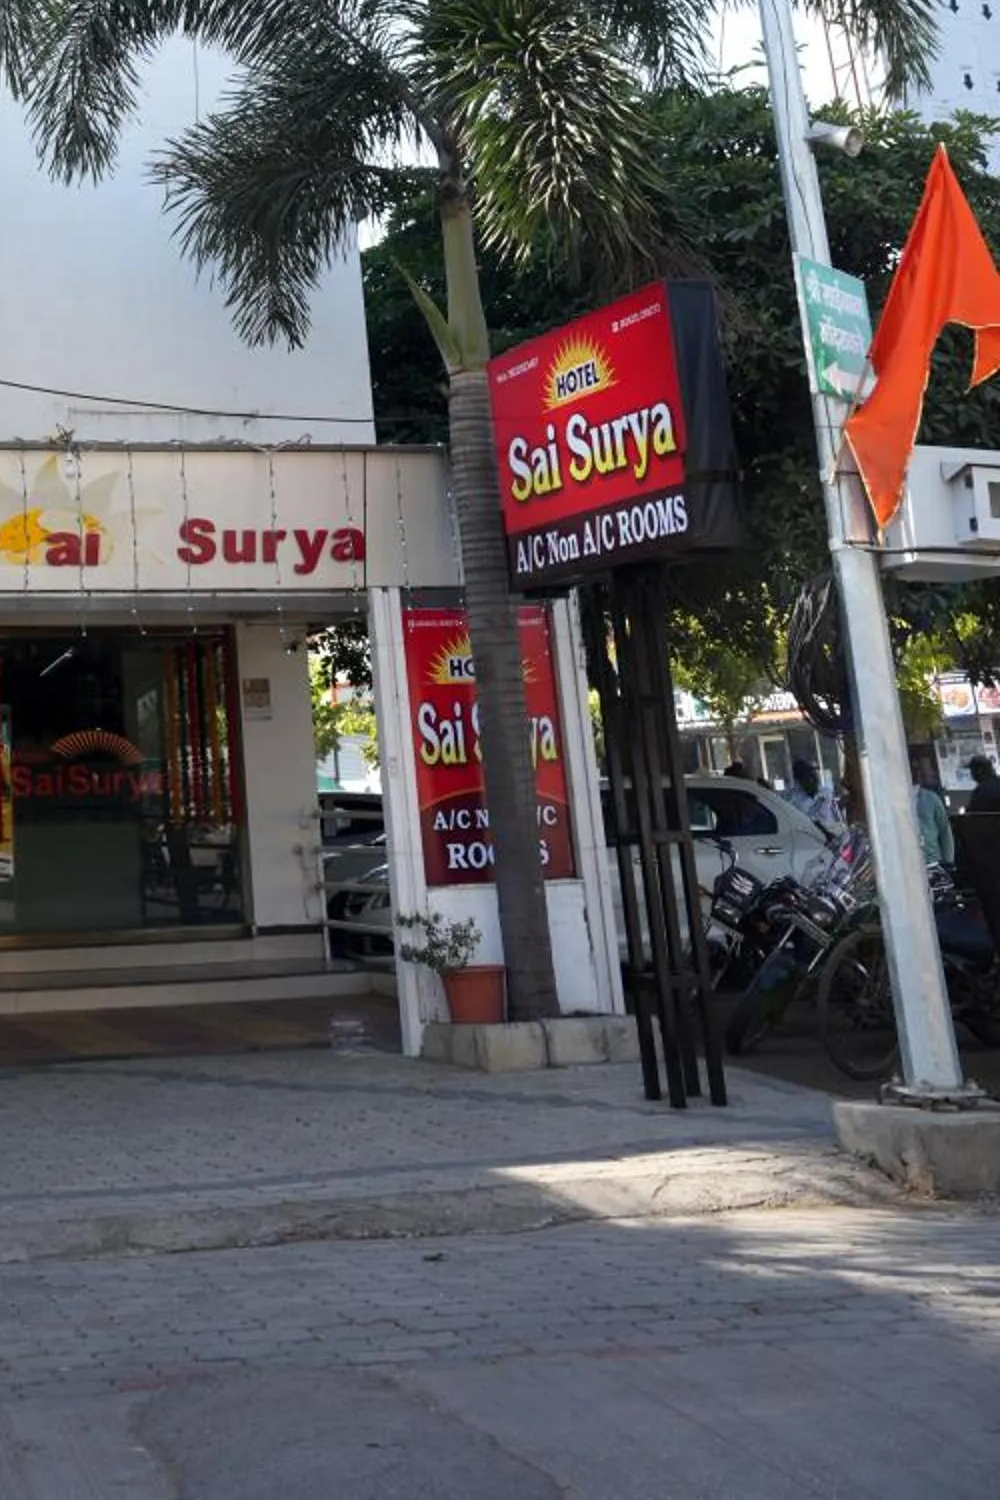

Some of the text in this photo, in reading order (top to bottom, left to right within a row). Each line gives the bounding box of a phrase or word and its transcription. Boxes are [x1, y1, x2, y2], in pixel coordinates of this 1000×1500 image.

[556, 361, 600, 396] HOTEL
[508, 402, 677, 501] Sai Surya
[177, 517, 366, 574] Surya
[516, 494, 689, 574] A/C Non A/C ROOMS
[418, 702, 467, 765] Sai
[433, 808, 471, 831] A/C
[446, 840, 550, 870] ROS
